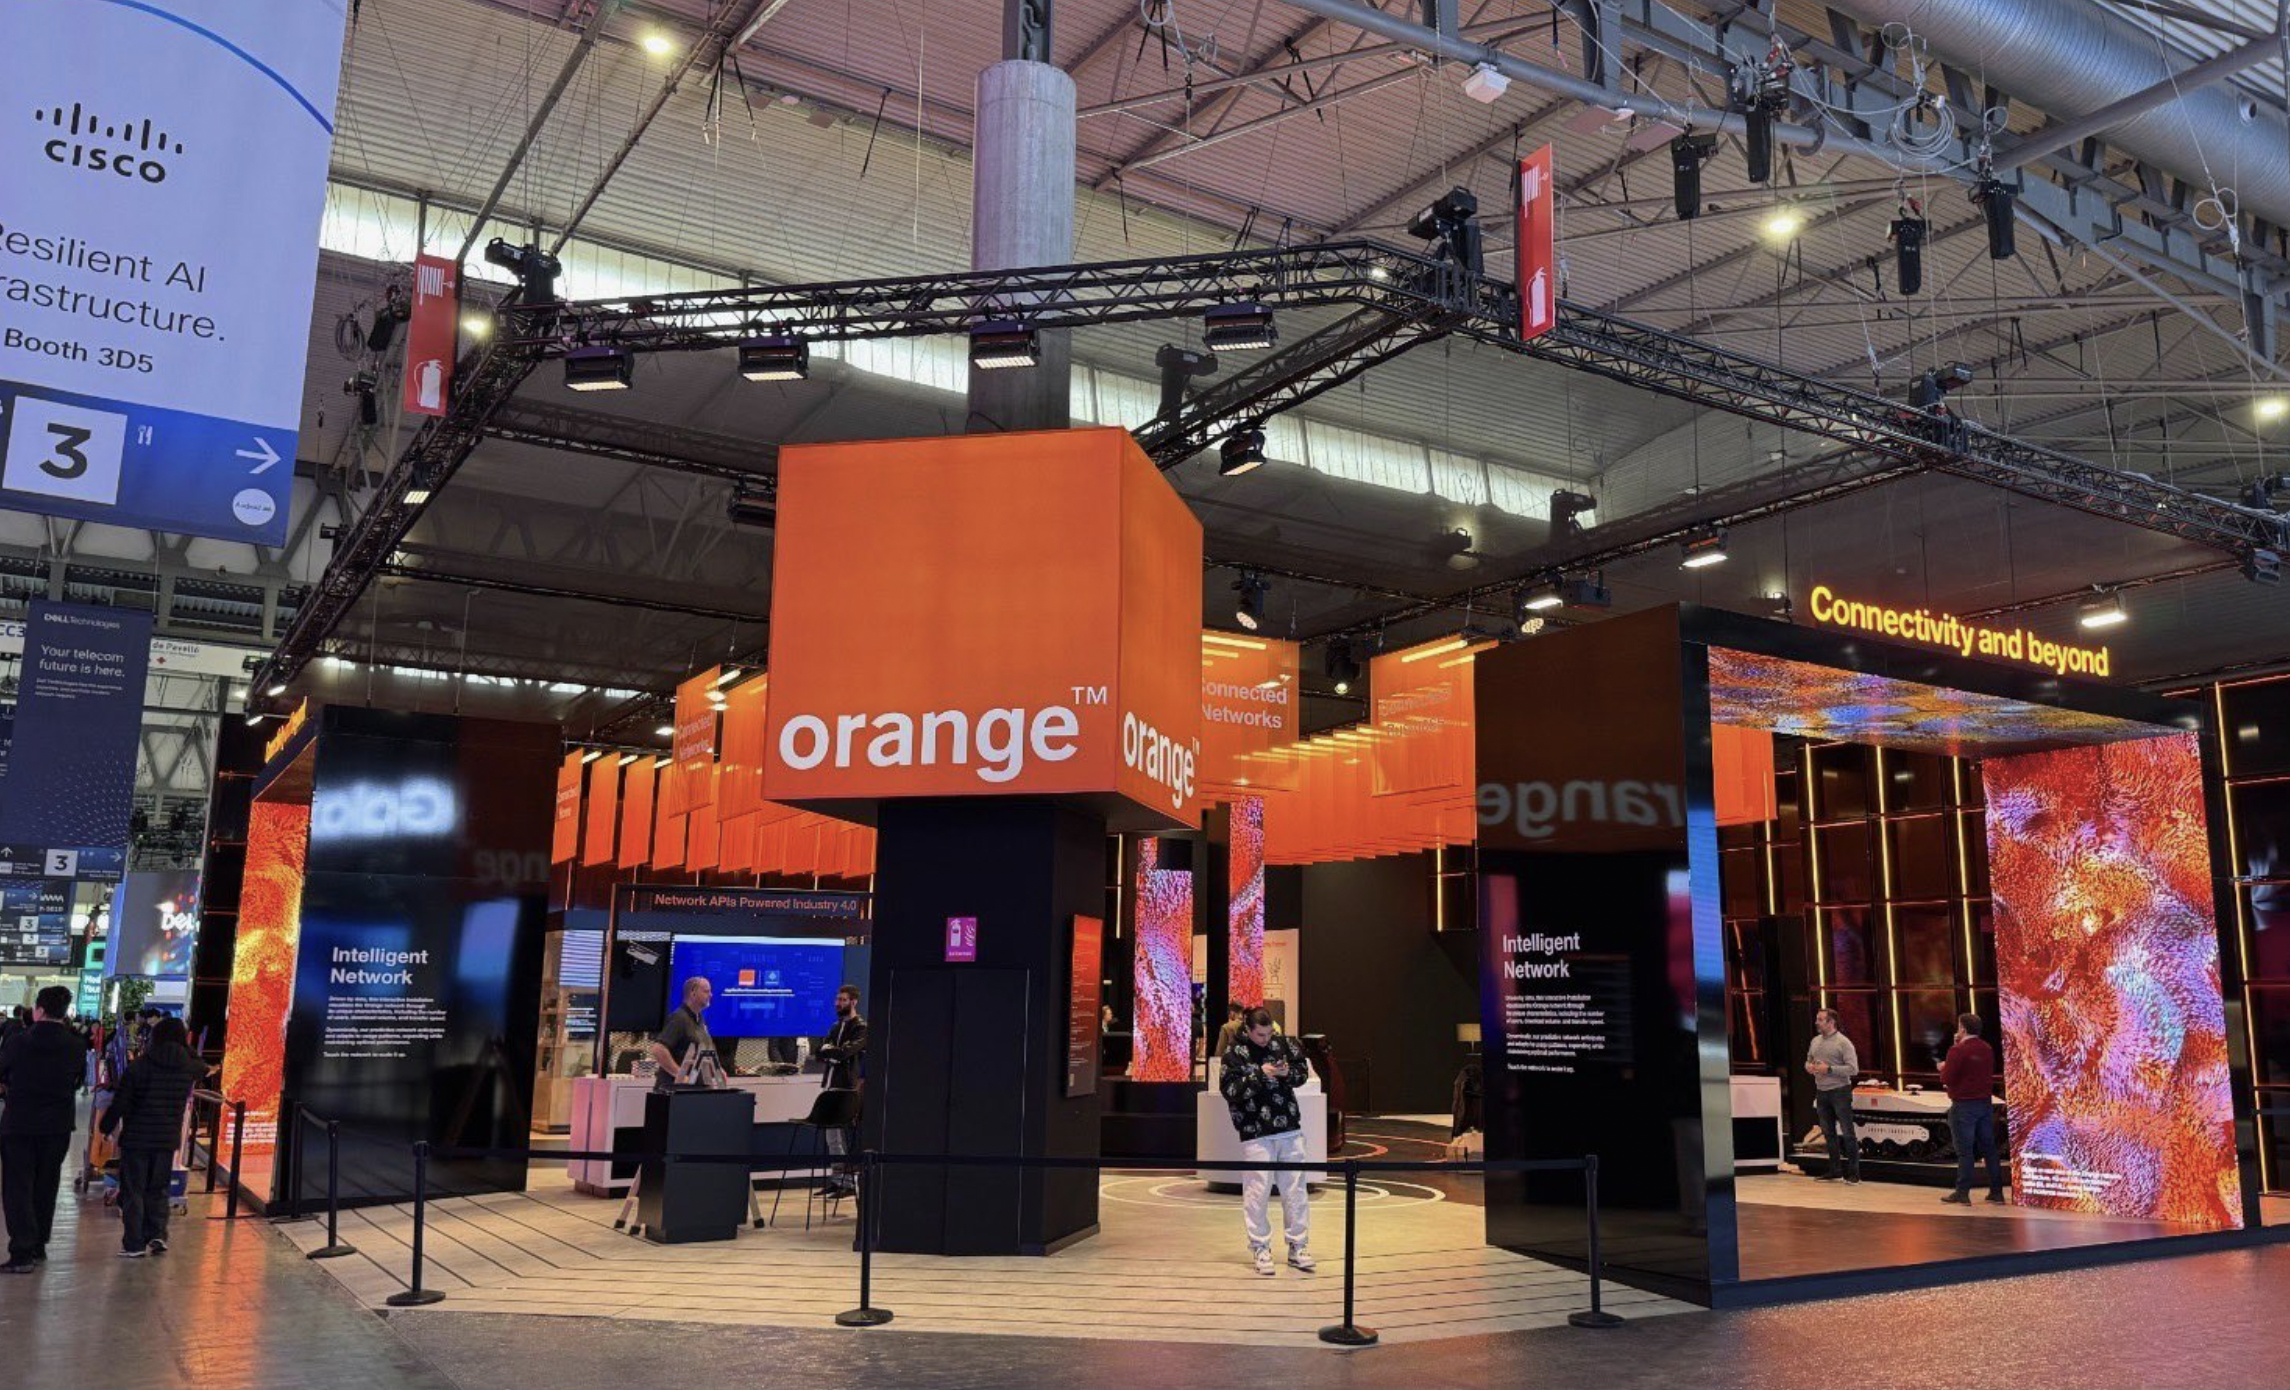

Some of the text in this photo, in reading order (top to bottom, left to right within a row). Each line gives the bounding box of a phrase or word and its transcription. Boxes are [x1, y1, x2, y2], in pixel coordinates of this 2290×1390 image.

[0, 223, 205, 293] esilient AI
[4, 328, 154, 373] Booth 3D5
[39, 422, 91, 479] 3
[1811, 585, 2109, 677] Connectivity and beyond
[41, 644, 124, 663] Your telecom
[39, 658, 125, 678] future is here.
[1202, 680, 1288, 705] onnected
[779, 686, 1108, 783] orange TM
[1123, 711, 1195, 809] orange
[54, 855, 68, 871] 3
[654, 893, 857, 912] Network APIs Powered Industry 4.0
[1502, 932, 1580, 956] Intelligent
[332, 946, 429, 967] Intelligent
[330, 968, 413, 985] Network
[1503, 959, 1570, 979] Network
